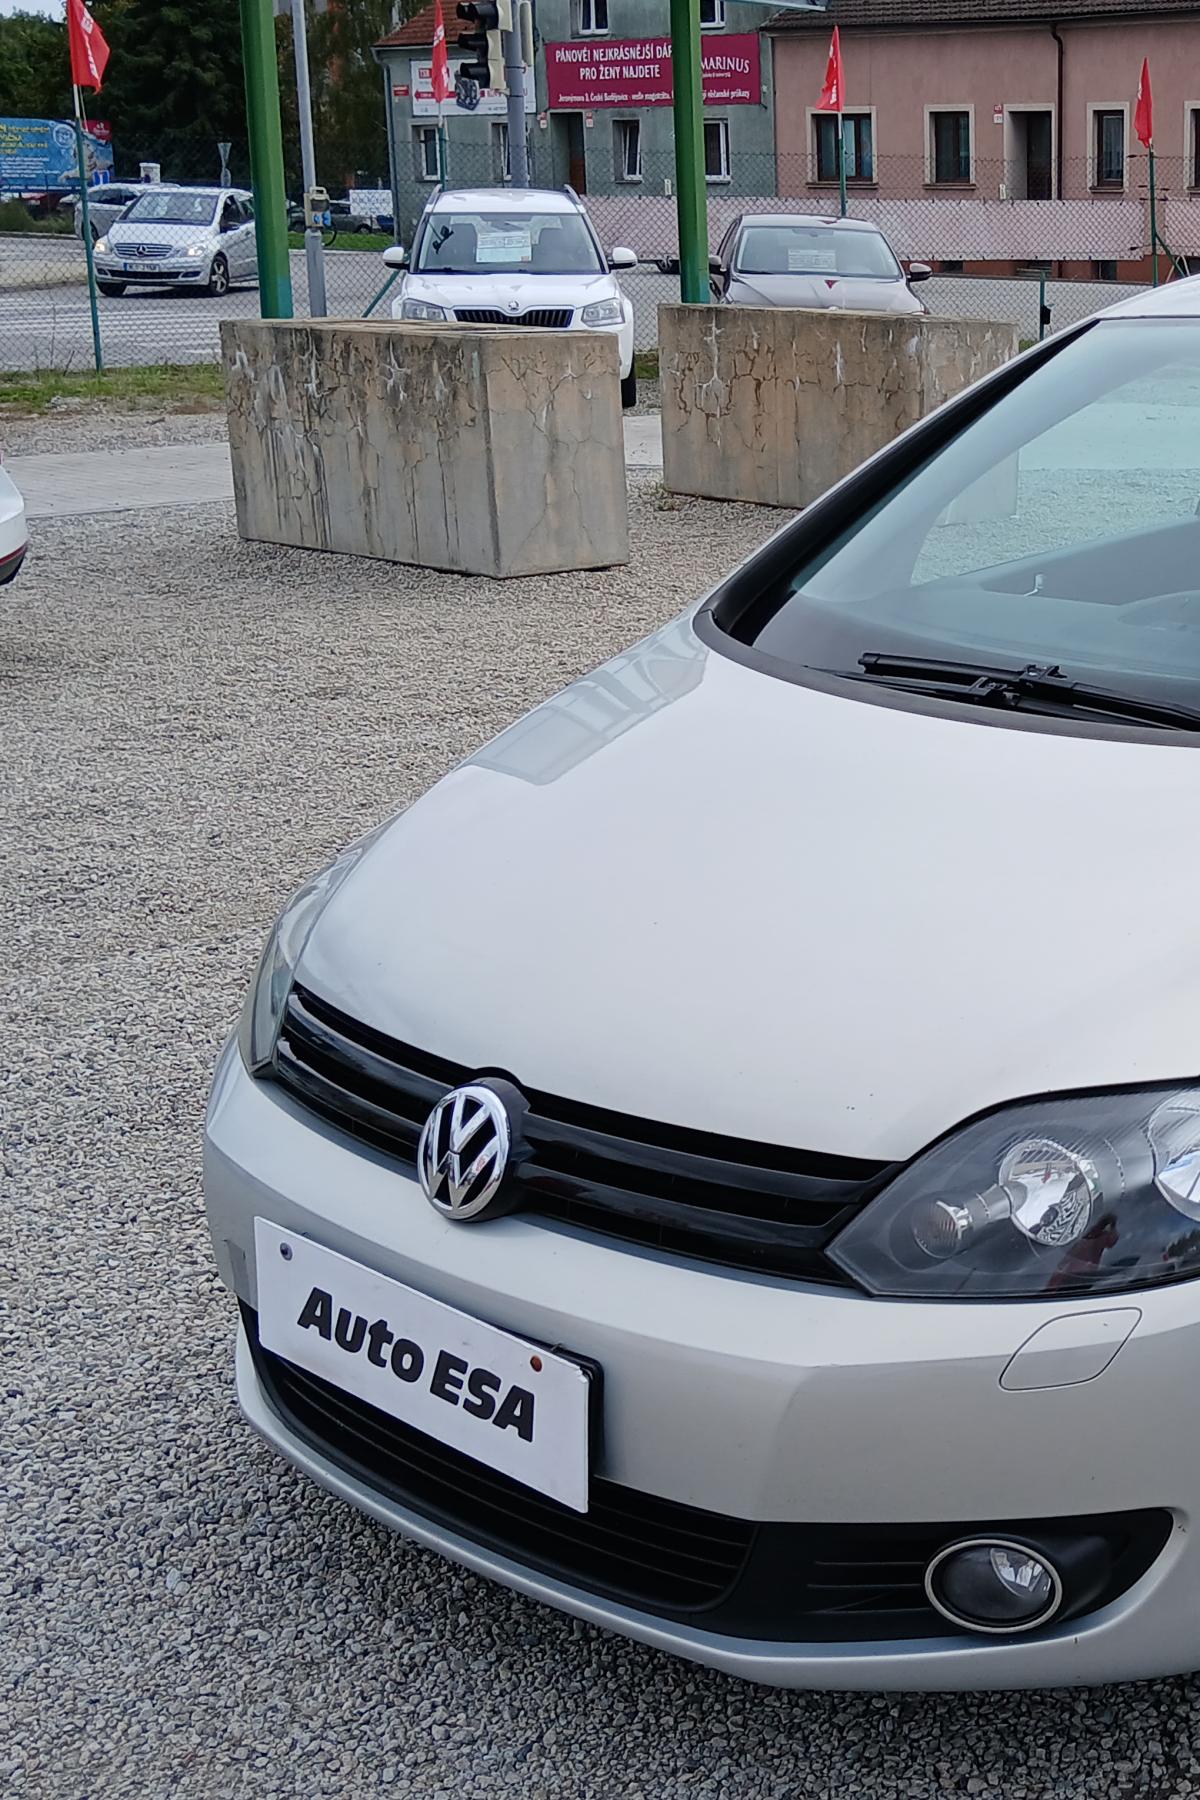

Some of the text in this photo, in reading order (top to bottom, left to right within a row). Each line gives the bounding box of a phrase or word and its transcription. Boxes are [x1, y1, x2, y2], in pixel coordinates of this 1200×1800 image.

[579, 64, 661, 80] PRO ŽENY NAJDETE
[700, 56, 750, 74] MARINUS
[297, 1286, 536, 1444] Auto ESA
